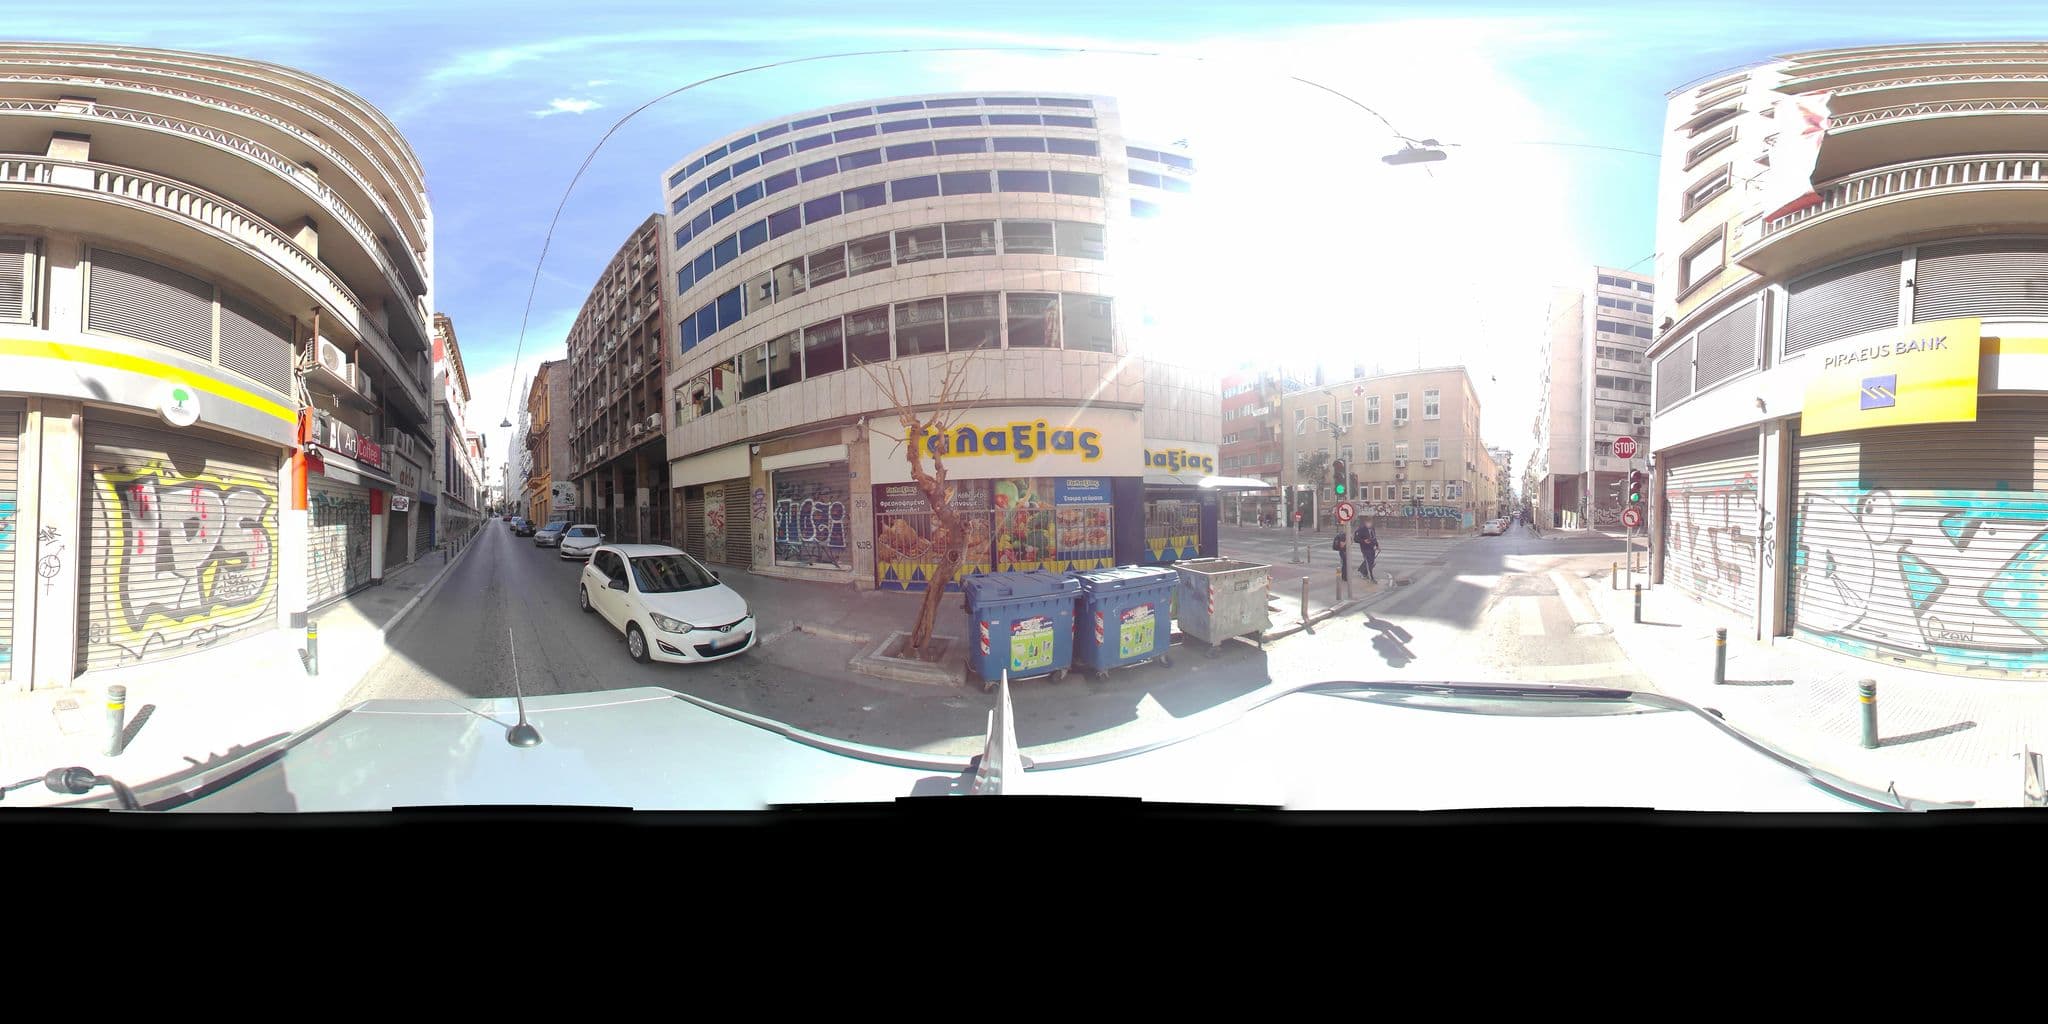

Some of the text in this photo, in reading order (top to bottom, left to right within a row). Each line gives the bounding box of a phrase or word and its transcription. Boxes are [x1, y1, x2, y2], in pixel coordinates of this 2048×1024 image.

[1825, 335, 1948, 370] PIRAEUS BANK
[1614, 442, 1635, 454] STOP
